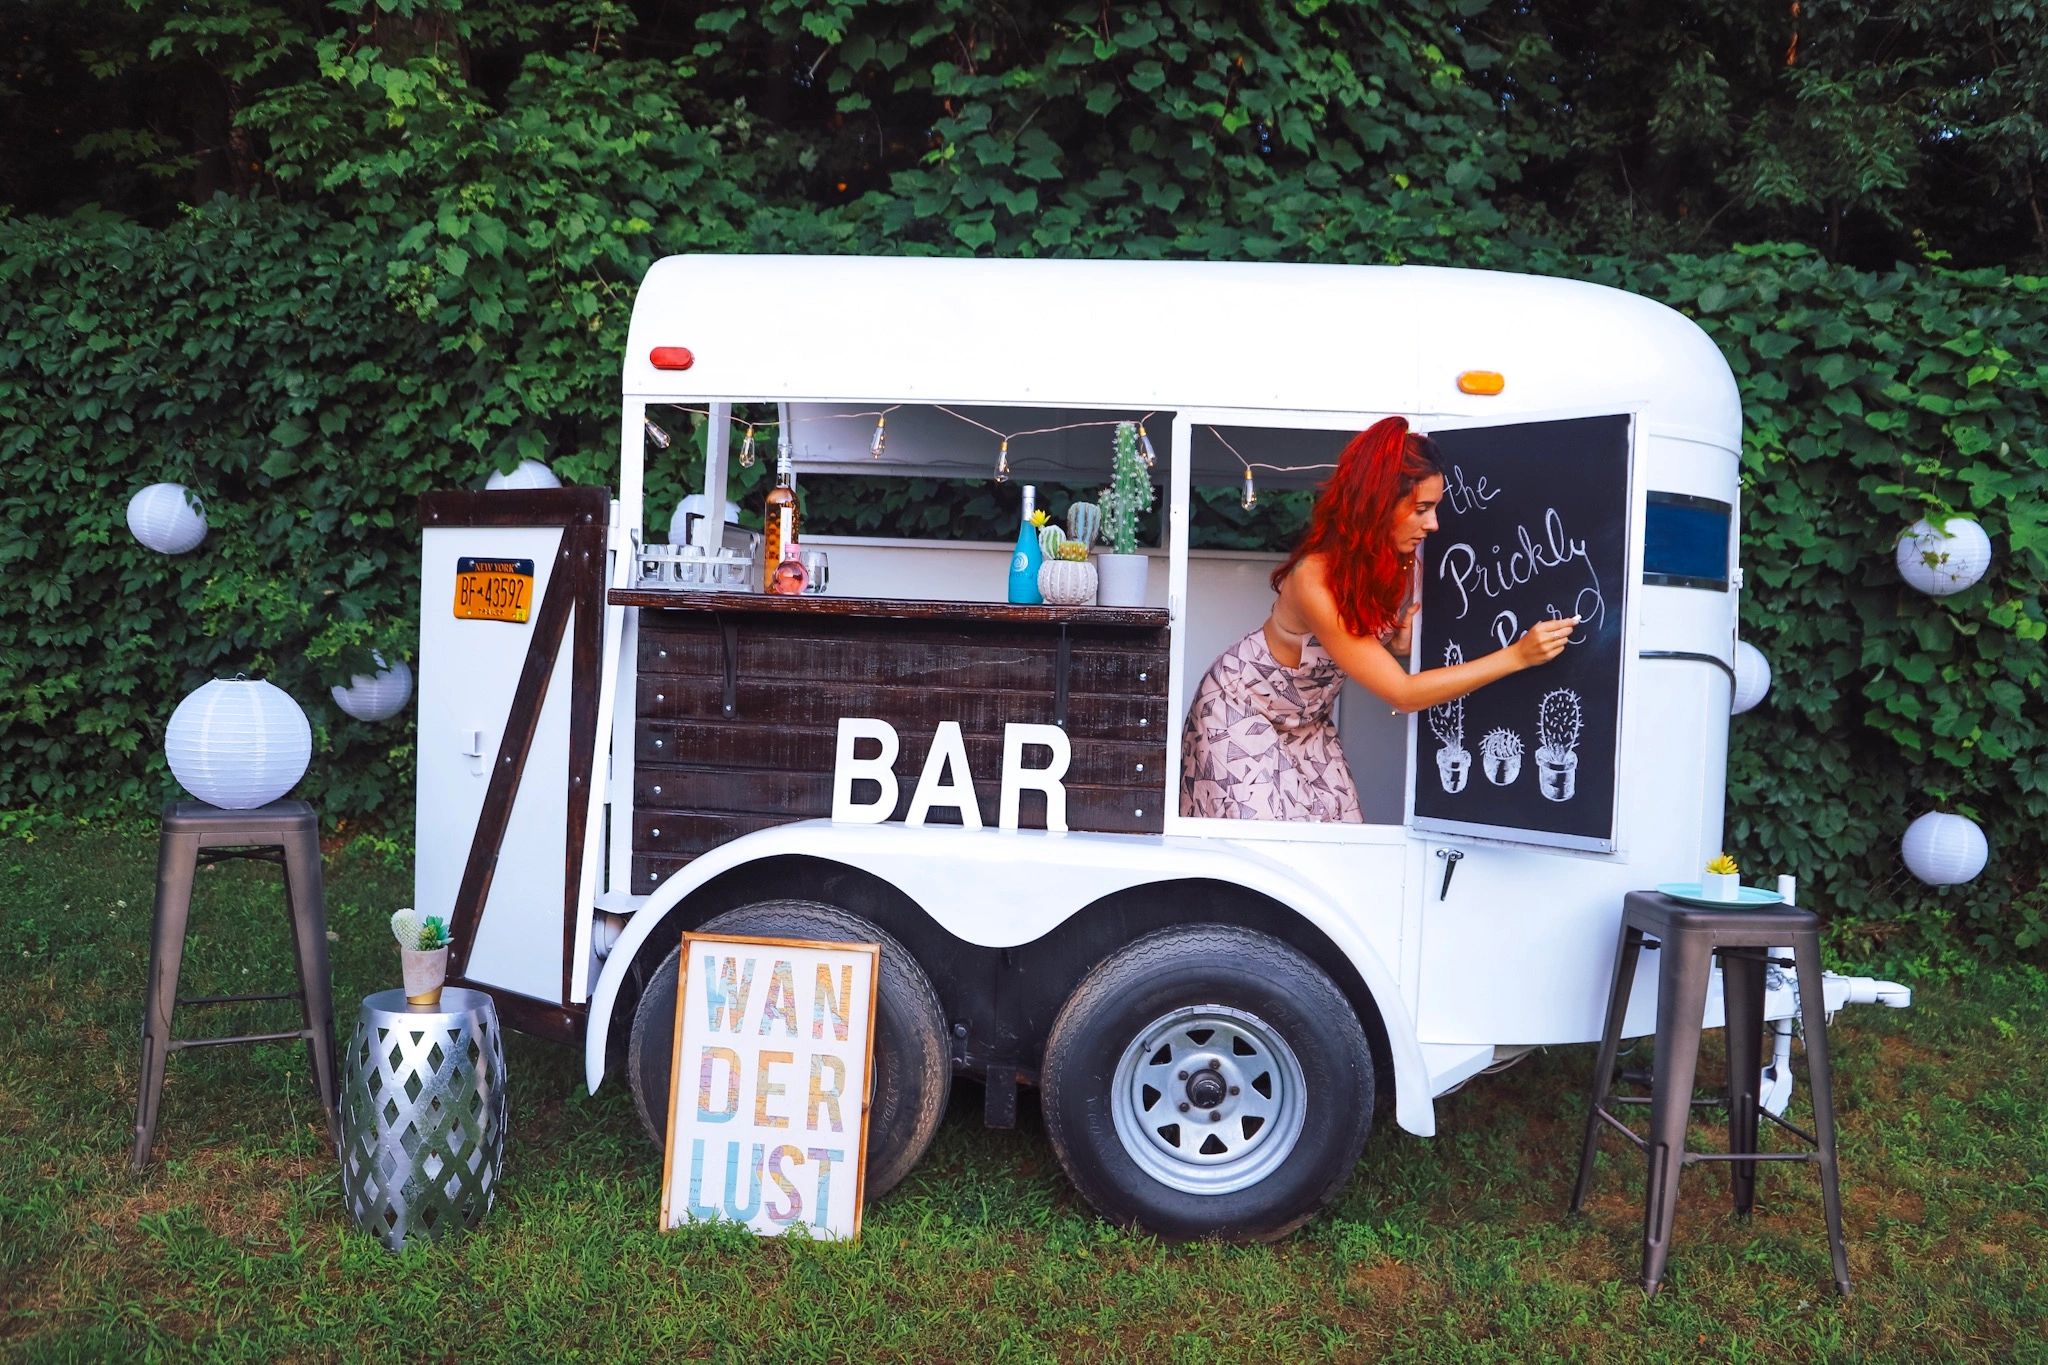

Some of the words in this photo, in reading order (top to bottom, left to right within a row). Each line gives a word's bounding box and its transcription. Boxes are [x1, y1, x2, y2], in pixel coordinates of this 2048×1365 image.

[1443, 464, 1501, 514] the
[475, 562, 493, 572] NEW
[494, 563, 515, 573] YORK
[1439, 508, 1605, 631] Prickly
[831, 717, 1072, 832] BAR
[704, 955, 852, 1041] WAN
[697, 1046, 846, 1132] DER
[688, 1139, 845, 1228] LUST
